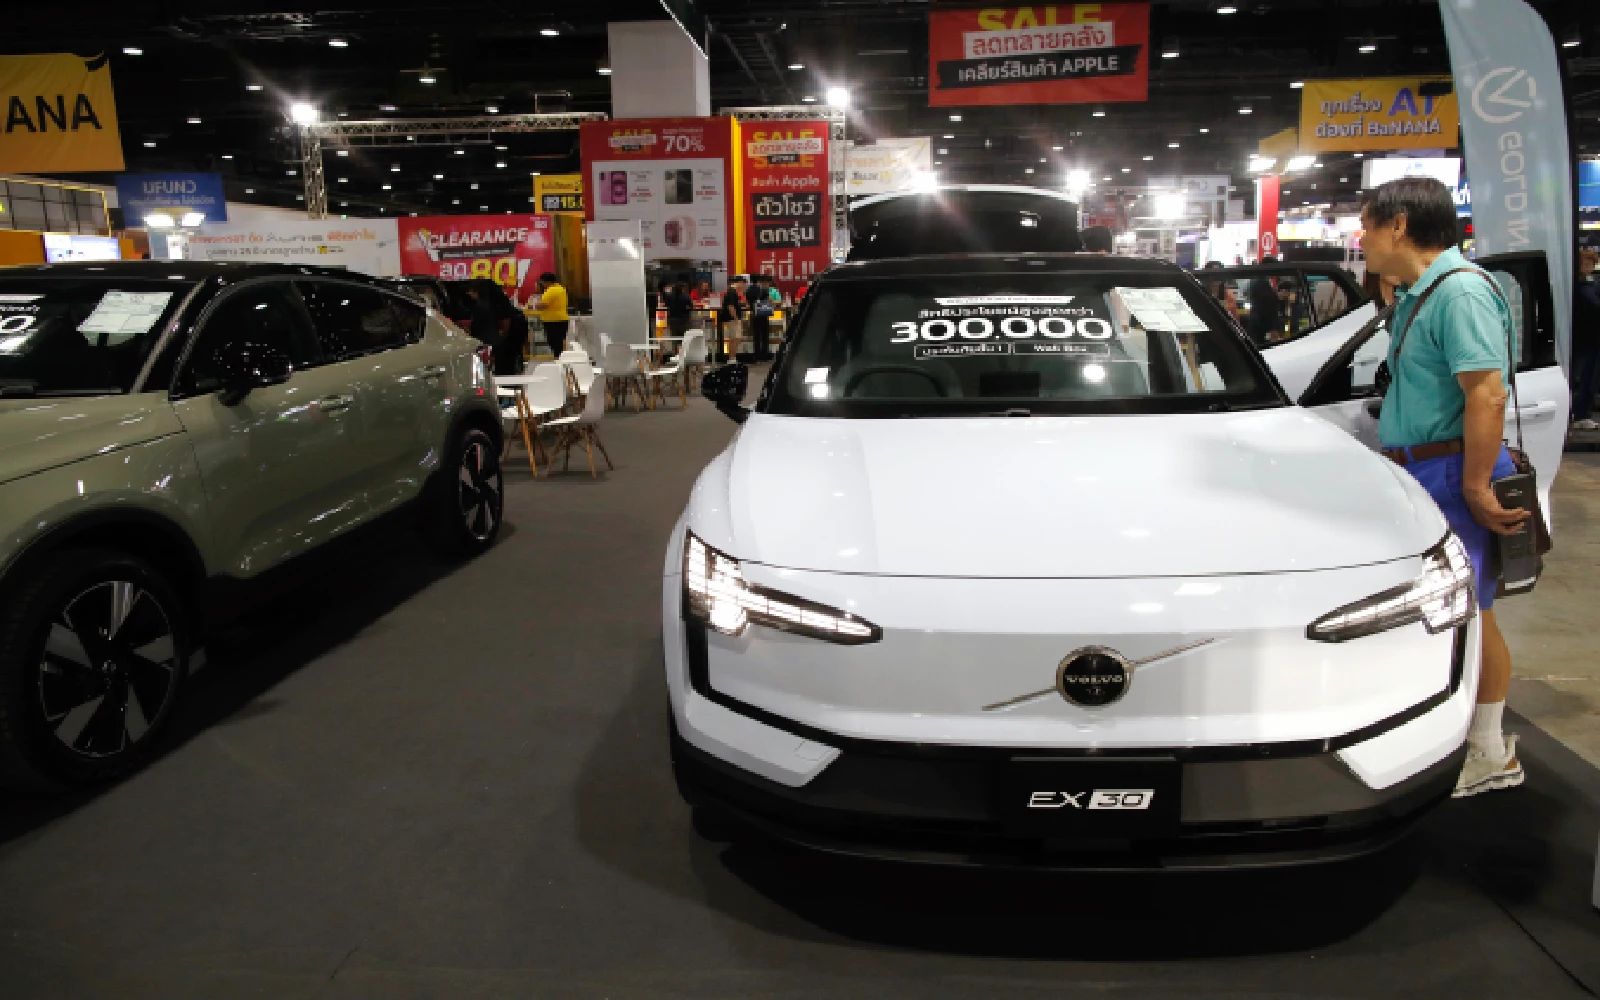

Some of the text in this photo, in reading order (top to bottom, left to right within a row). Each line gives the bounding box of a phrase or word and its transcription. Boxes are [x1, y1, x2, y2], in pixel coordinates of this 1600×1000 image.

[1060, 55, 1121, 74] APPLE
[662, 135, 706, 152] 70%
[782, 174, 820, 189] Apple
[430, 227, 529, 247] CLEARANCE
[1064, 674, 1123, 684] VOLVO
[1027, 791, 1086, 808] EX
